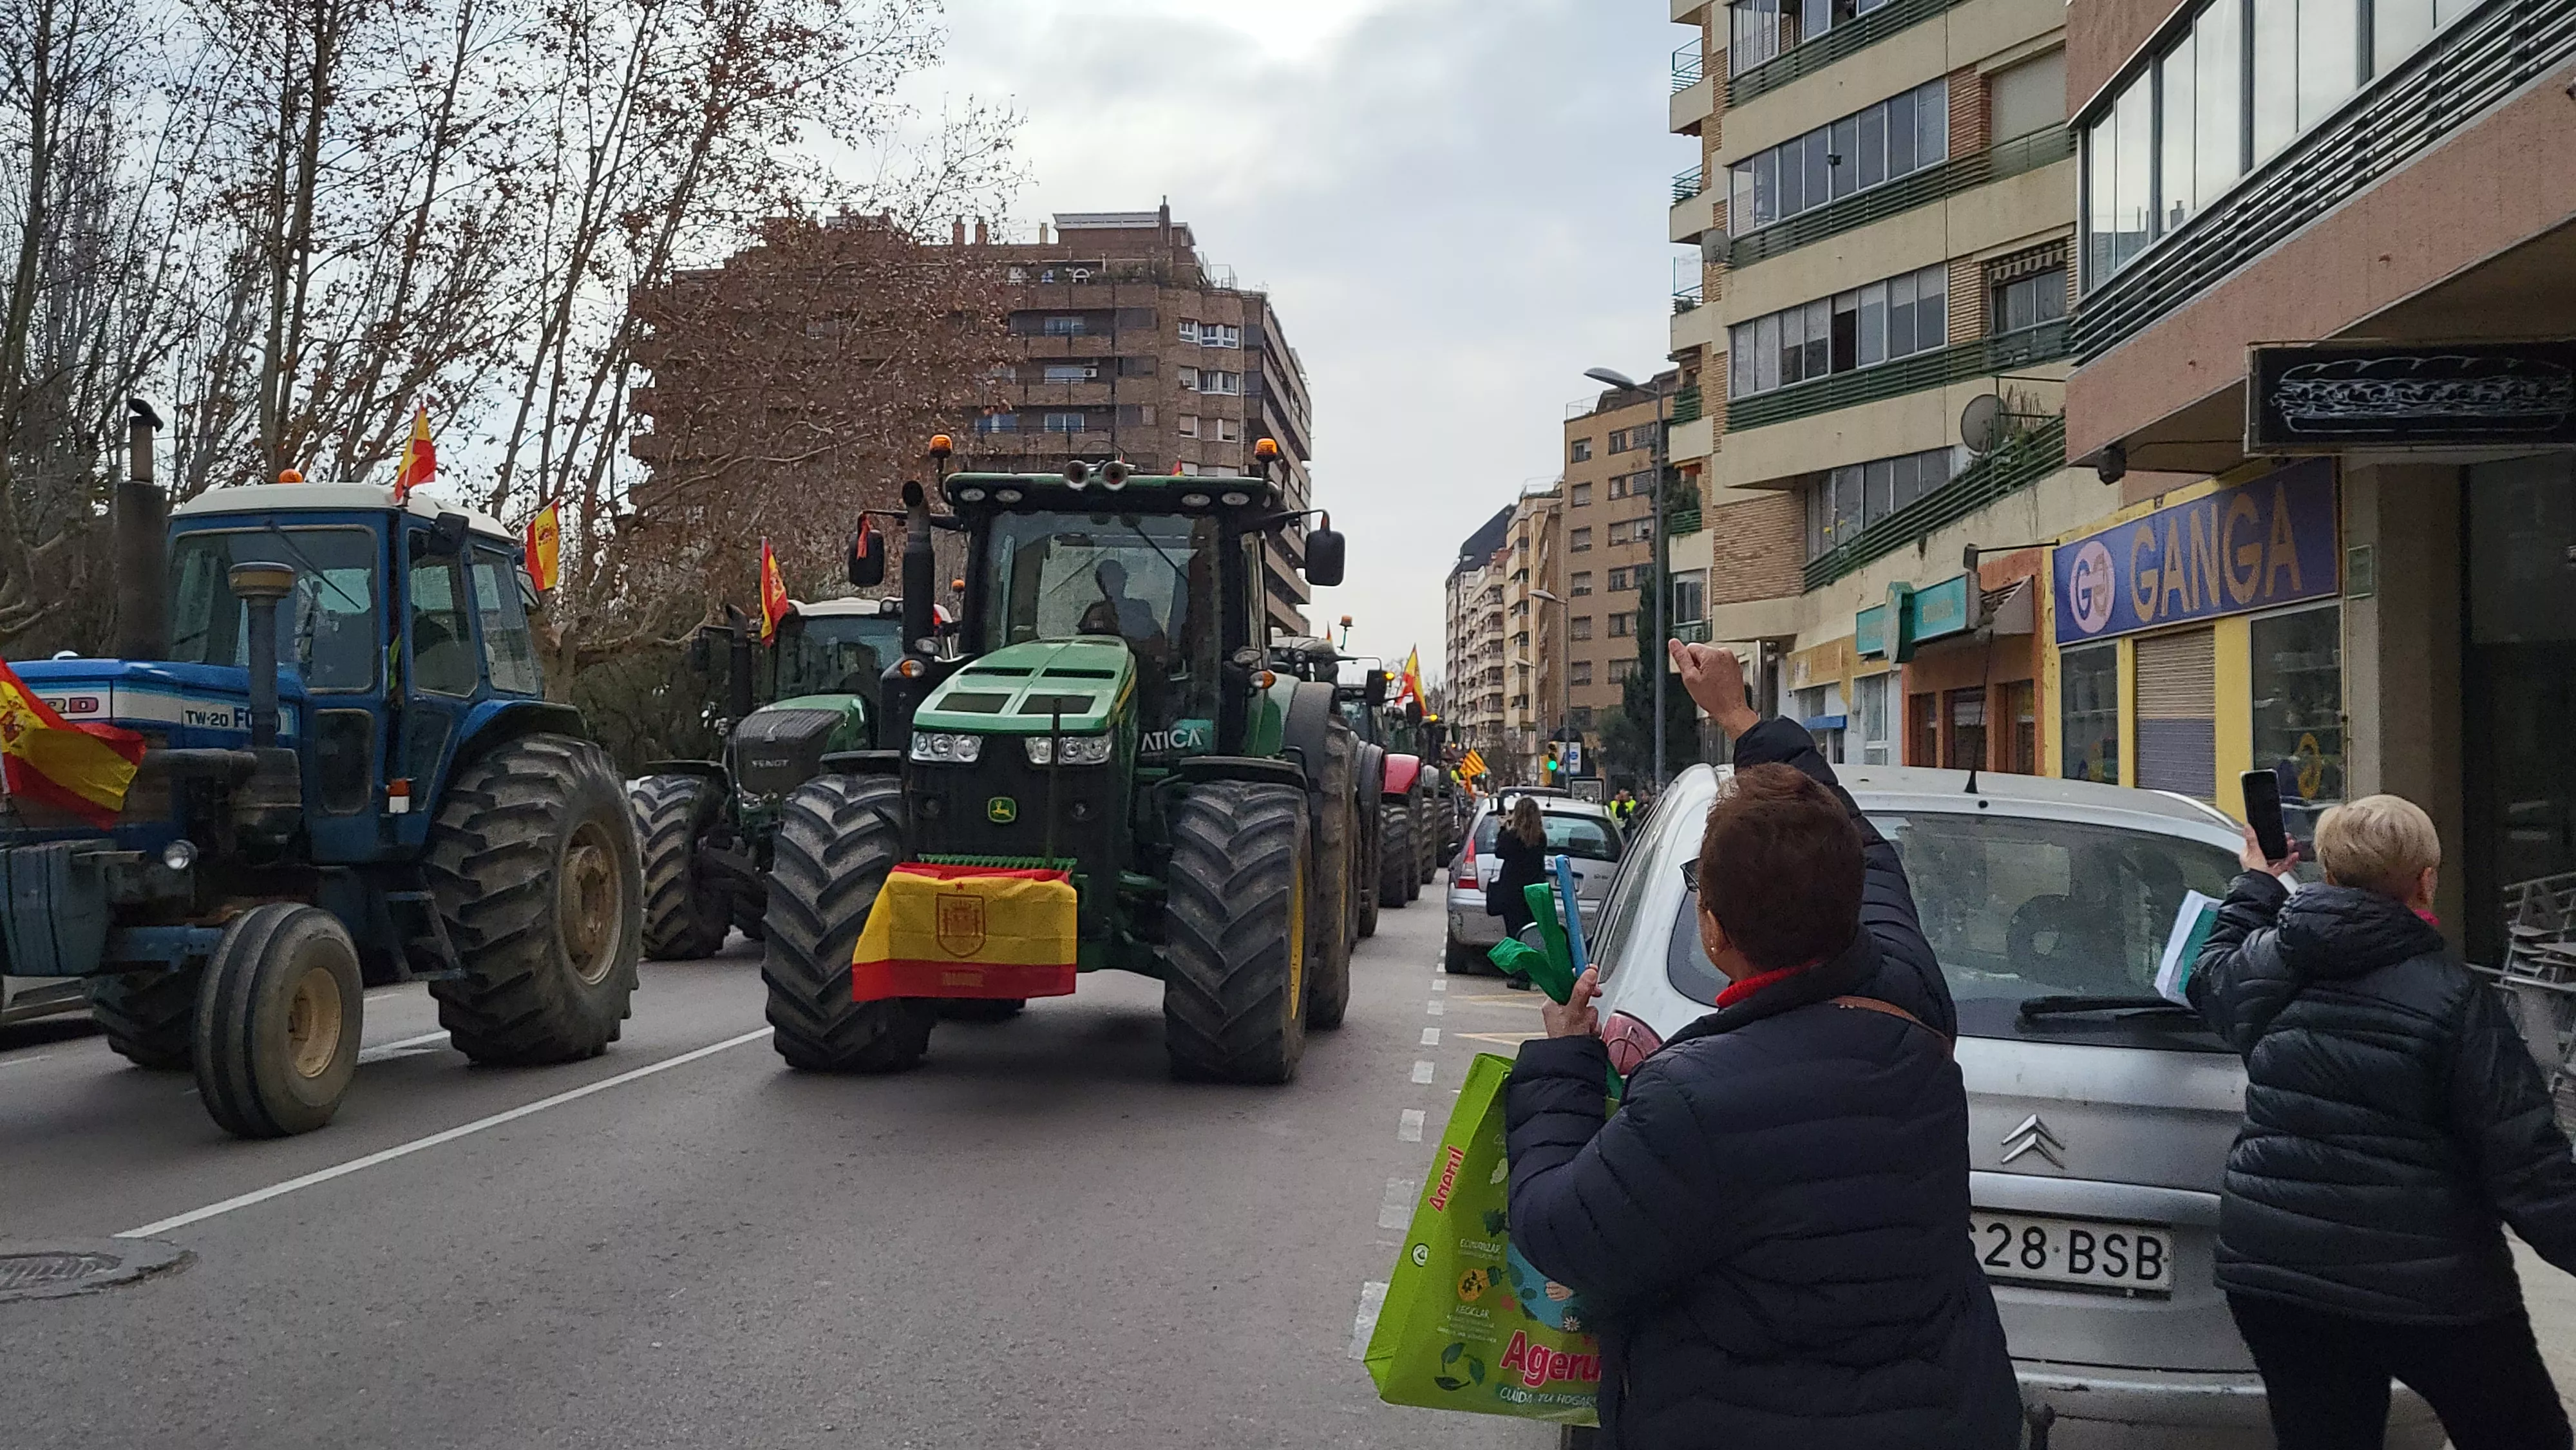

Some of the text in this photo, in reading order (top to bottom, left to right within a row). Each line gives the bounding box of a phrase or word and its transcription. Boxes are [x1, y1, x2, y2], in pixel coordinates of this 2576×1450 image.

[2130, 481, 2302, 623] GANGA
[41, 697, 99, 713] RD
[1968, 1223, 2163, 1280] 28 BSB
[1499, 1330, 1602, 1388] Ageru
